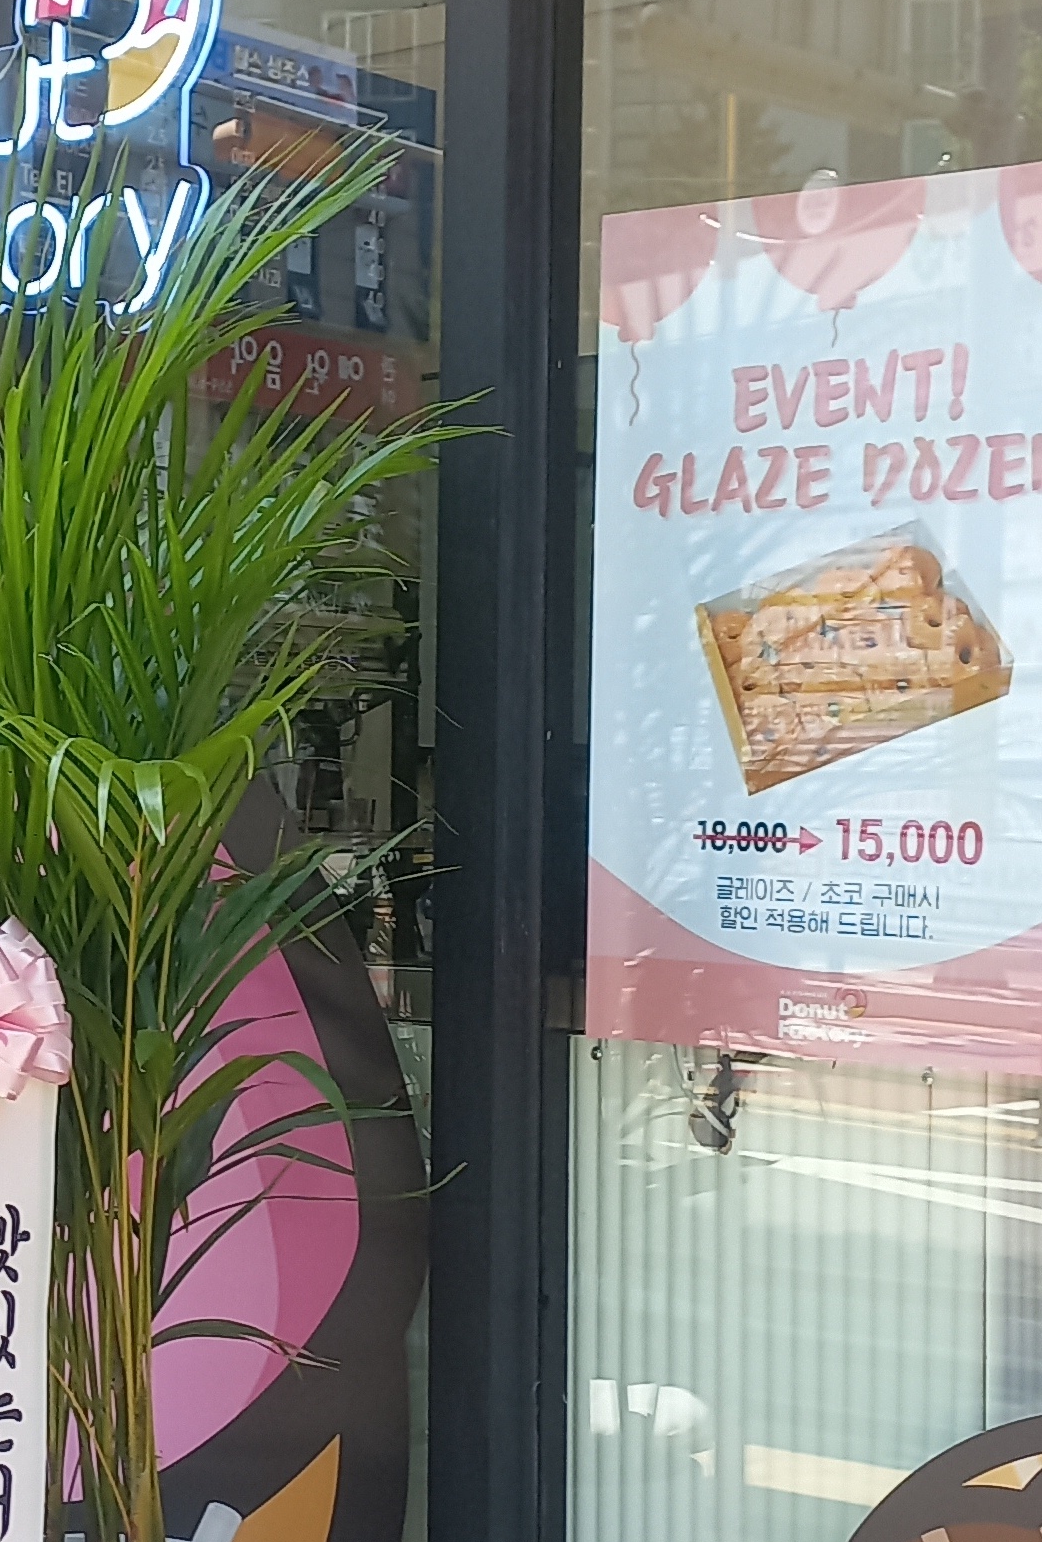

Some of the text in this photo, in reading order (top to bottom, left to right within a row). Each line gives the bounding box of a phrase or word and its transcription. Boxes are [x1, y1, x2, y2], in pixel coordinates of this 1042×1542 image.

[731, 342, 969, 434] EVENT!
[633, 445, 831, 519] GLAZE
[698, 818, 984, 867] 18,000 15,000
[715, 876, 795, 903] 글레이즈
[820, 880, 864, 906] 초코
[872, 882, 940, 909] 구매시
[720, 904, 934, 940] 할인 적용해 드립니다.
[778, 997, 849, 1020] Donut
